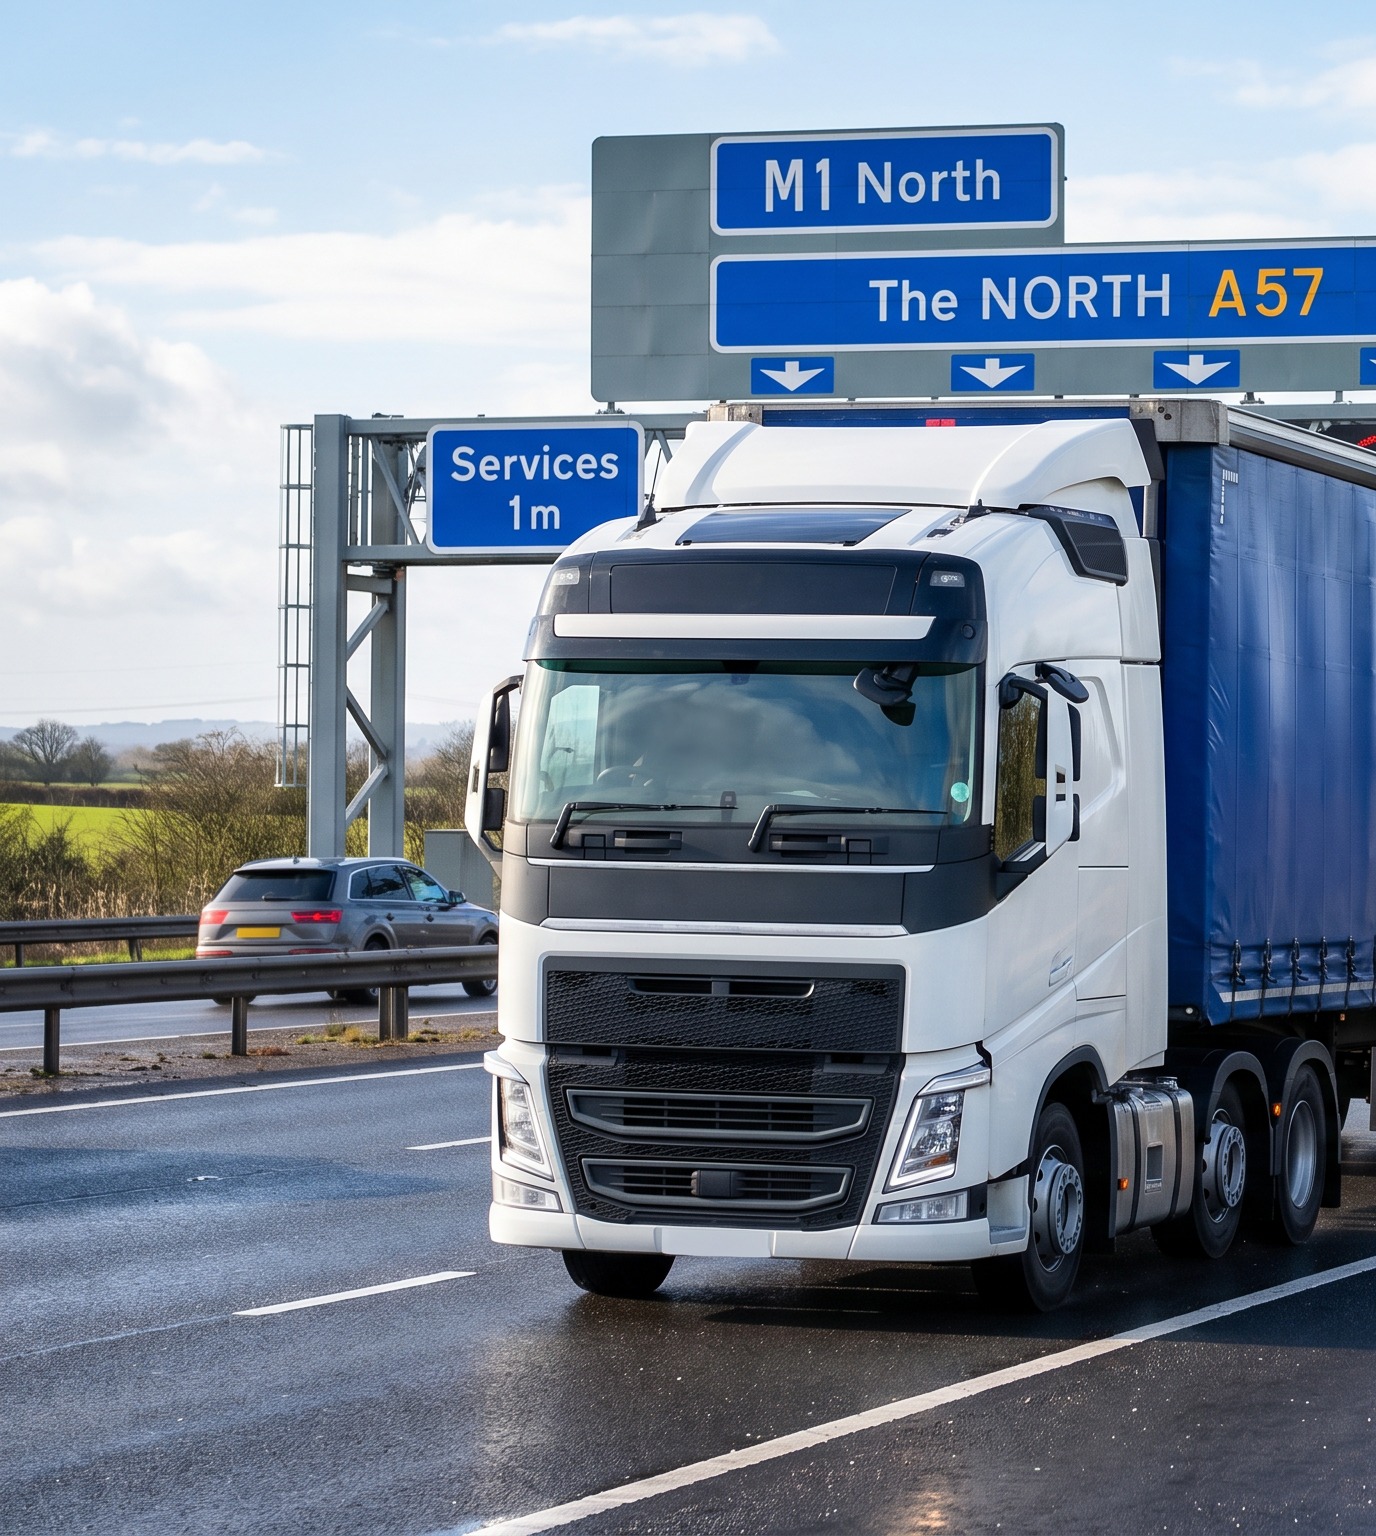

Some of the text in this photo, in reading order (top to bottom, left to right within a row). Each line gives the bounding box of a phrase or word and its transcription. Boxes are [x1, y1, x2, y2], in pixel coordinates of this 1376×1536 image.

[765, 158, 1000, 213] M1 North
[869, 267, 1324, 322] The NORTH A57
[451, 444, 619, 482] Services
[509, 495, 560, 530] 1m
